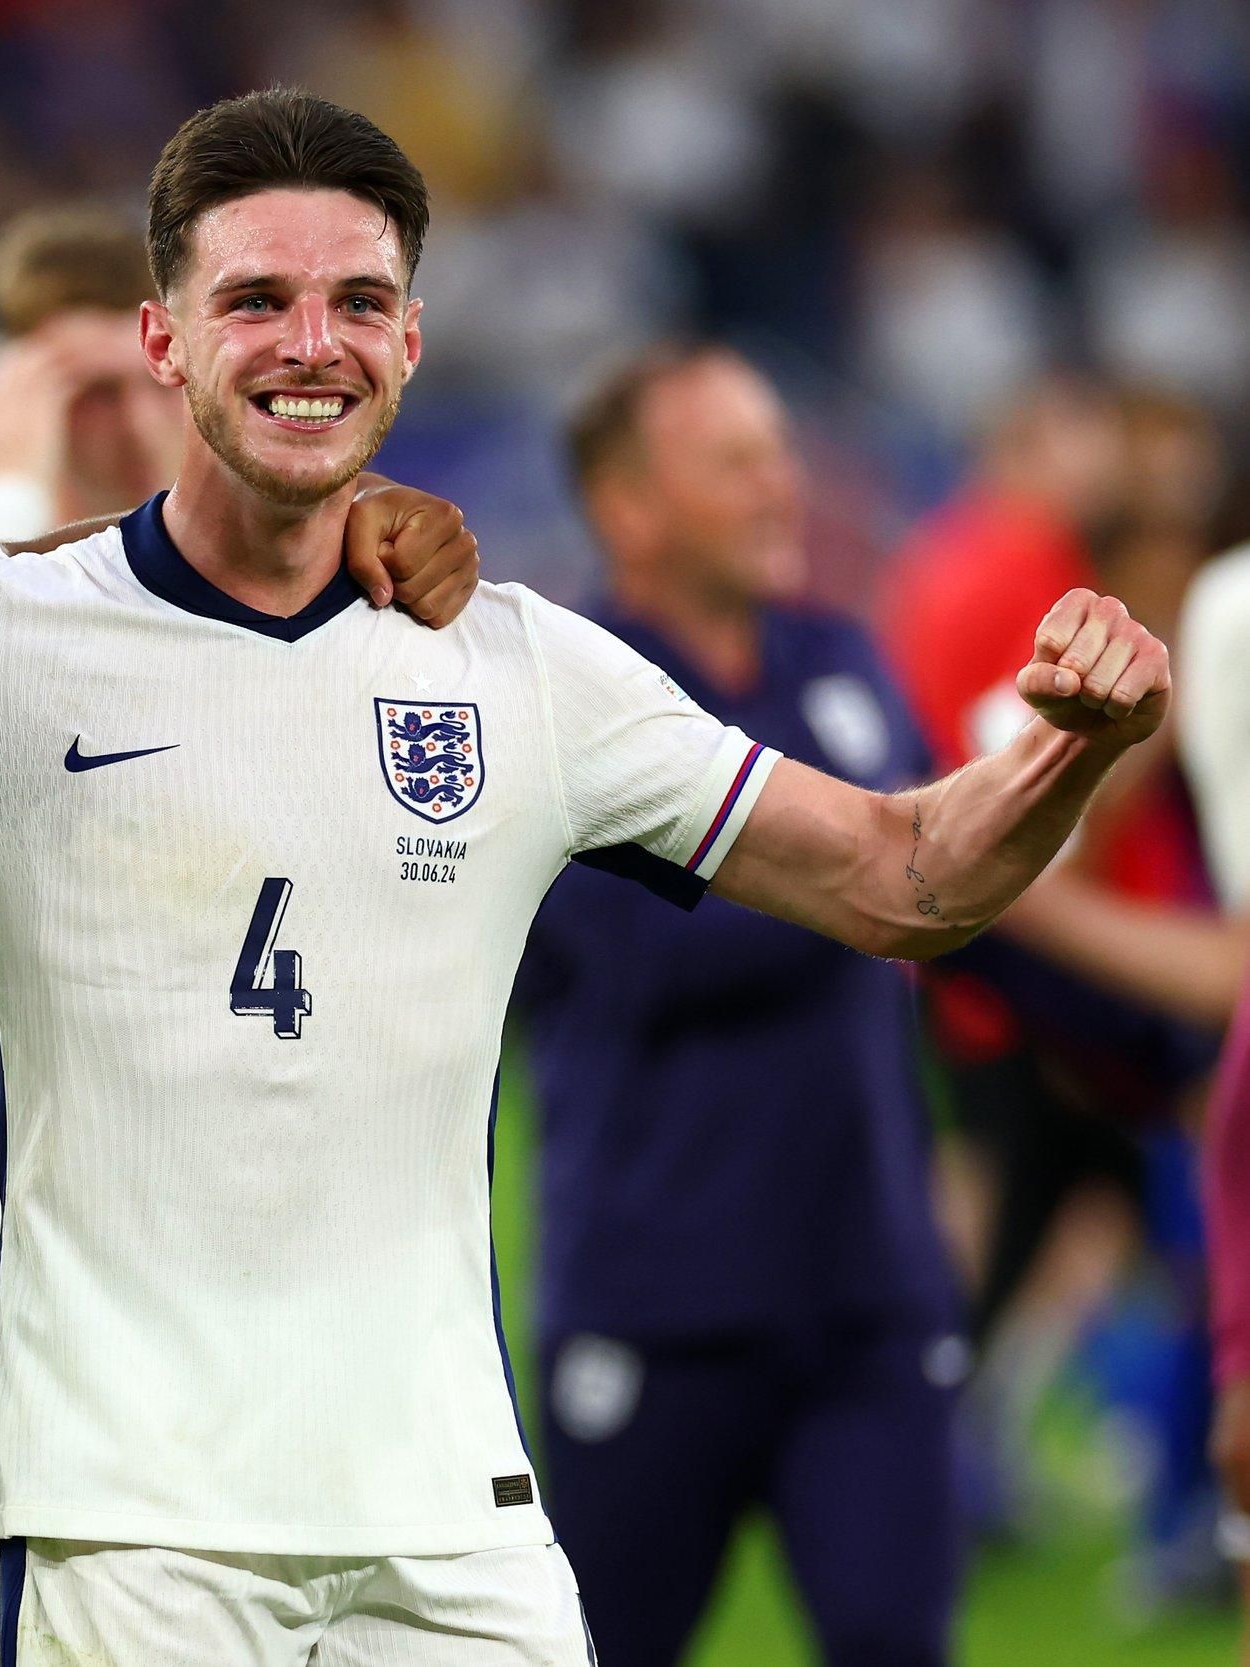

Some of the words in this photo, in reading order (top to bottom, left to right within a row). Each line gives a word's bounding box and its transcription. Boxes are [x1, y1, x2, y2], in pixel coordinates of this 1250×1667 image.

[396, 836, 467, 860] SLOVAKIA
[400, 862, 456, 883] 30.06.24
[229, 877, 312, 1040] 4
